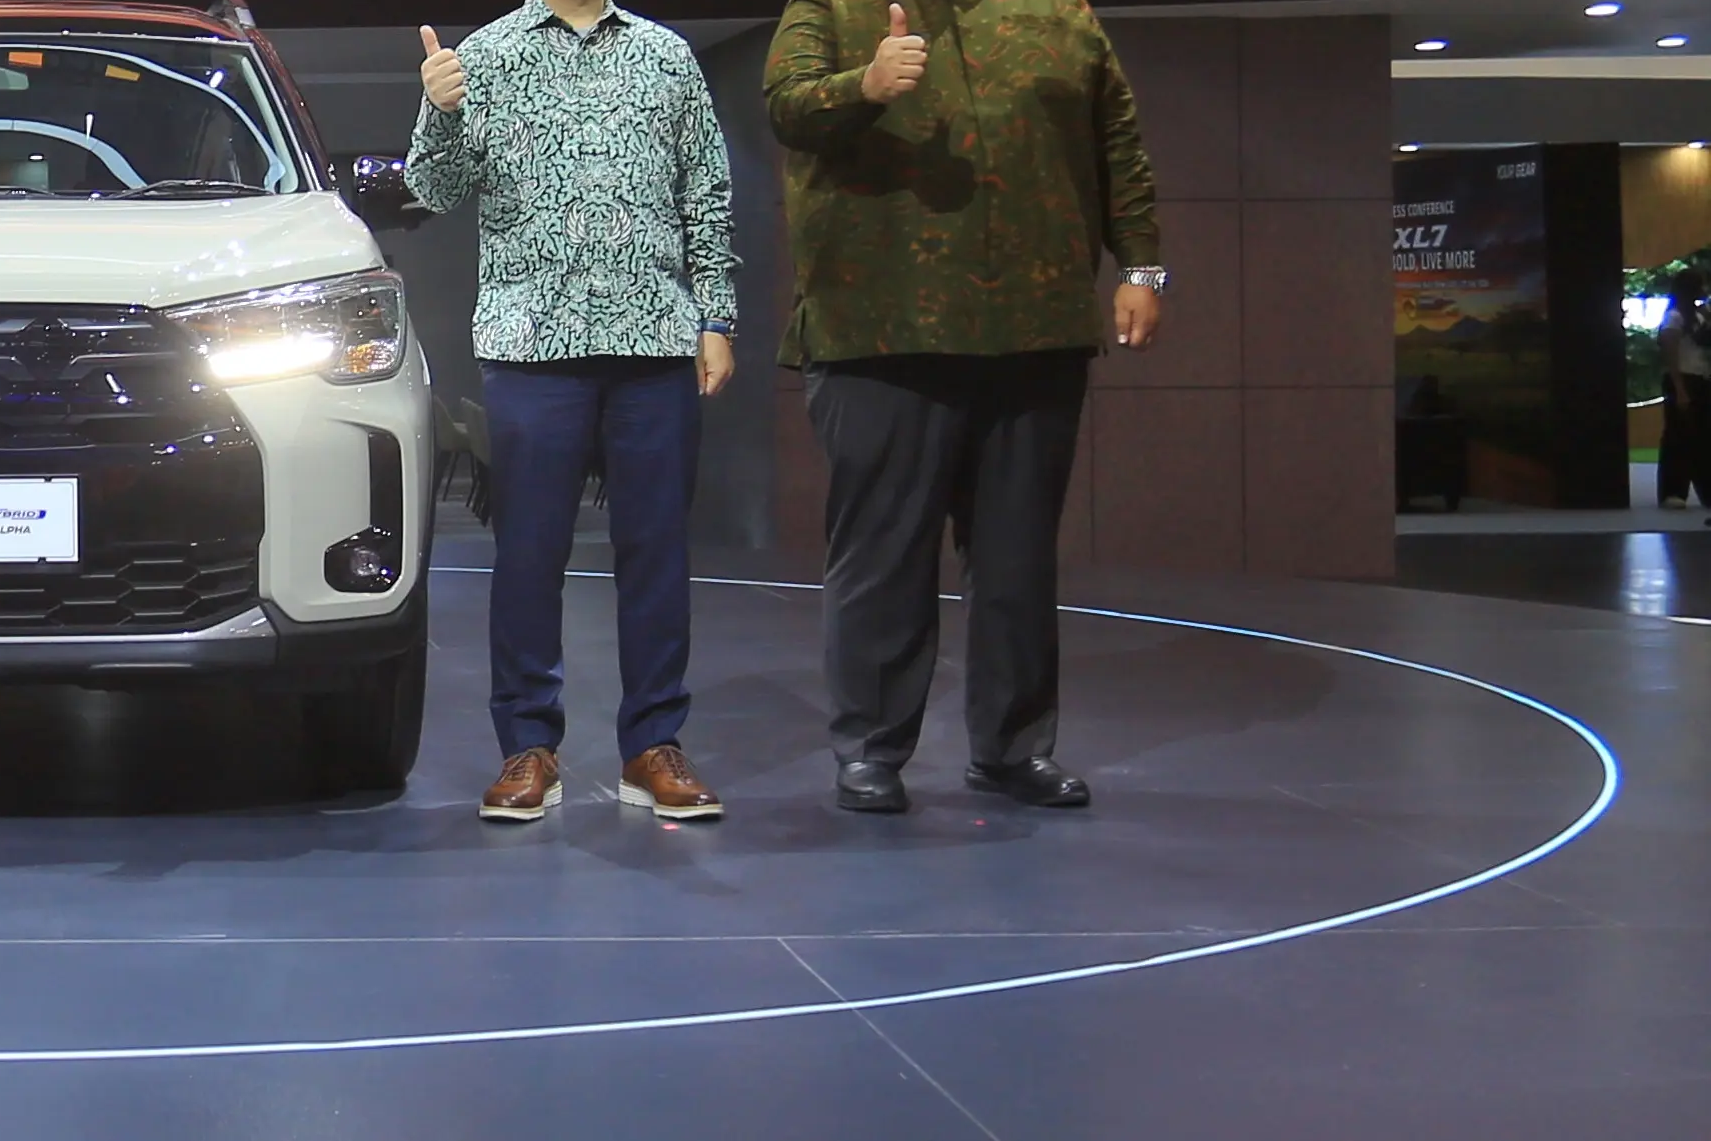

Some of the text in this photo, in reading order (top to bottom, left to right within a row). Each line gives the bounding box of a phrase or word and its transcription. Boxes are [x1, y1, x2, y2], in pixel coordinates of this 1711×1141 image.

[1407, 200, 1455, 216] CONFERENCE
[1393, 224, 1448, 249] XL7
[1421, 252, 1443, 270] LIVE
[1445, 250, 1476, 269] MORE
